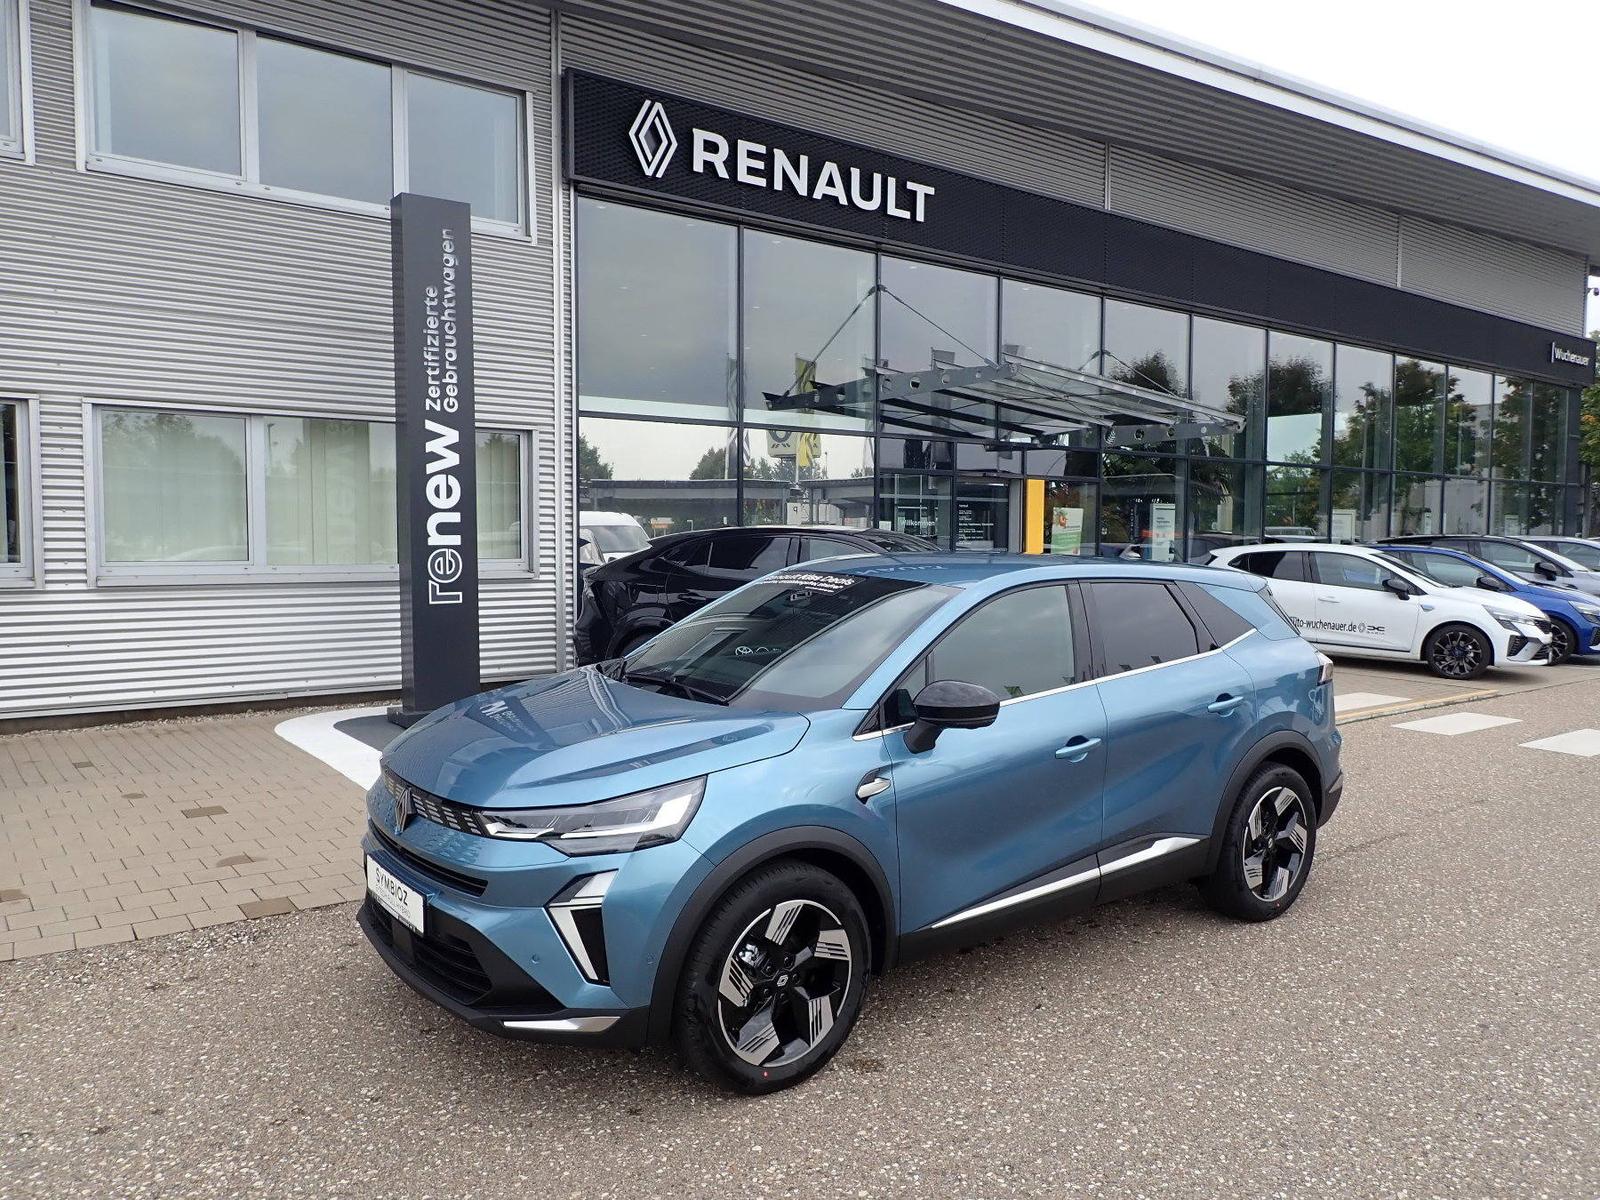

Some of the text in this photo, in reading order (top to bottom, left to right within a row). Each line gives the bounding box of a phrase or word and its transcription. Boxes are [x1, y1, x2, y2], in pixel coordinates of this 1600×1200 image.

[691, 127, 936, 223] RENAULT
[423, 285, 441, 412] Zertifizierte
[441, 227, 459, 413] Gebrauchtwagen
[424, 419, 463, 605] renew
[1292, 617, 1357, 632] to-wuchenauer.de
[375, 867, 408, 906] SYMBIOZ
